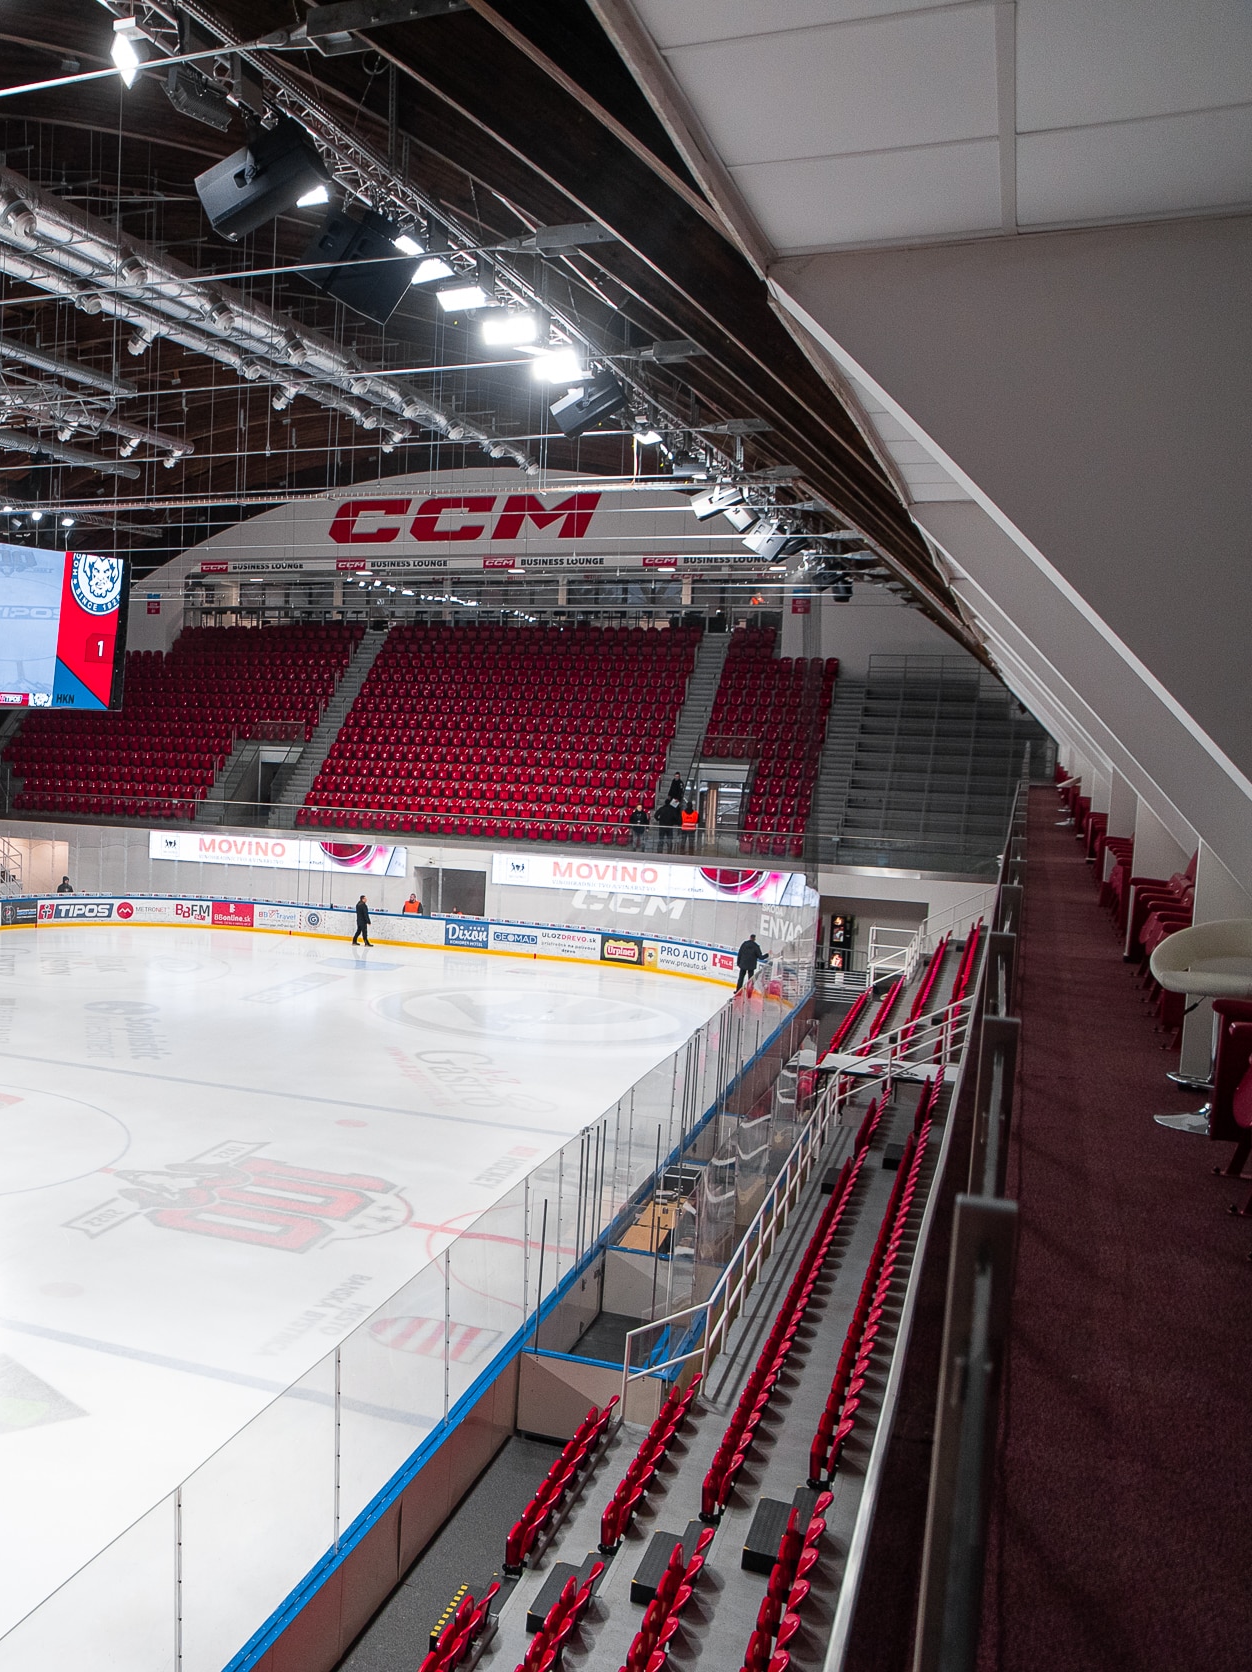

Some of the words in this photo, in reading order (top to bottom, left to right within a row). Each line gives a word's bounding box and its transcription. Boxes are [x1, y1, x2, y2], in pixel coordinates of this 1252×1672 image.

[329, 492, 602, 543] CCM
[370, 560, 410, 568] BUSINESS
[412, 559, 448, 567] LOUNGE
[521, 557, 564, 566] BUSINESS
[566, 556, 605, 566] LOUNGE
[733, 556, 768, 564] LOUN
[76, 588, 98, 611] SINCE
[97, 640, 104, 657] 1
[56, 694, 75, 704] HKN
[199, 837, 286, 857] MOVINO
[552, 861, 659, 884] MOVINO
[58, 904, 110, 917] TIPOS
[571, 890, 688, 920] CCM
[276, 911, 296, 920] Travel
[446, 924, 488, 941] Dixon
[494, 933, 537, 944] GEOMAD
[607, 946, 636, 960] Urpiner
[660, 945, 681, 958] PRO
[682, 949, 709, 963] AUTO
[659, 957, 708, 972] www.proauto.sk
